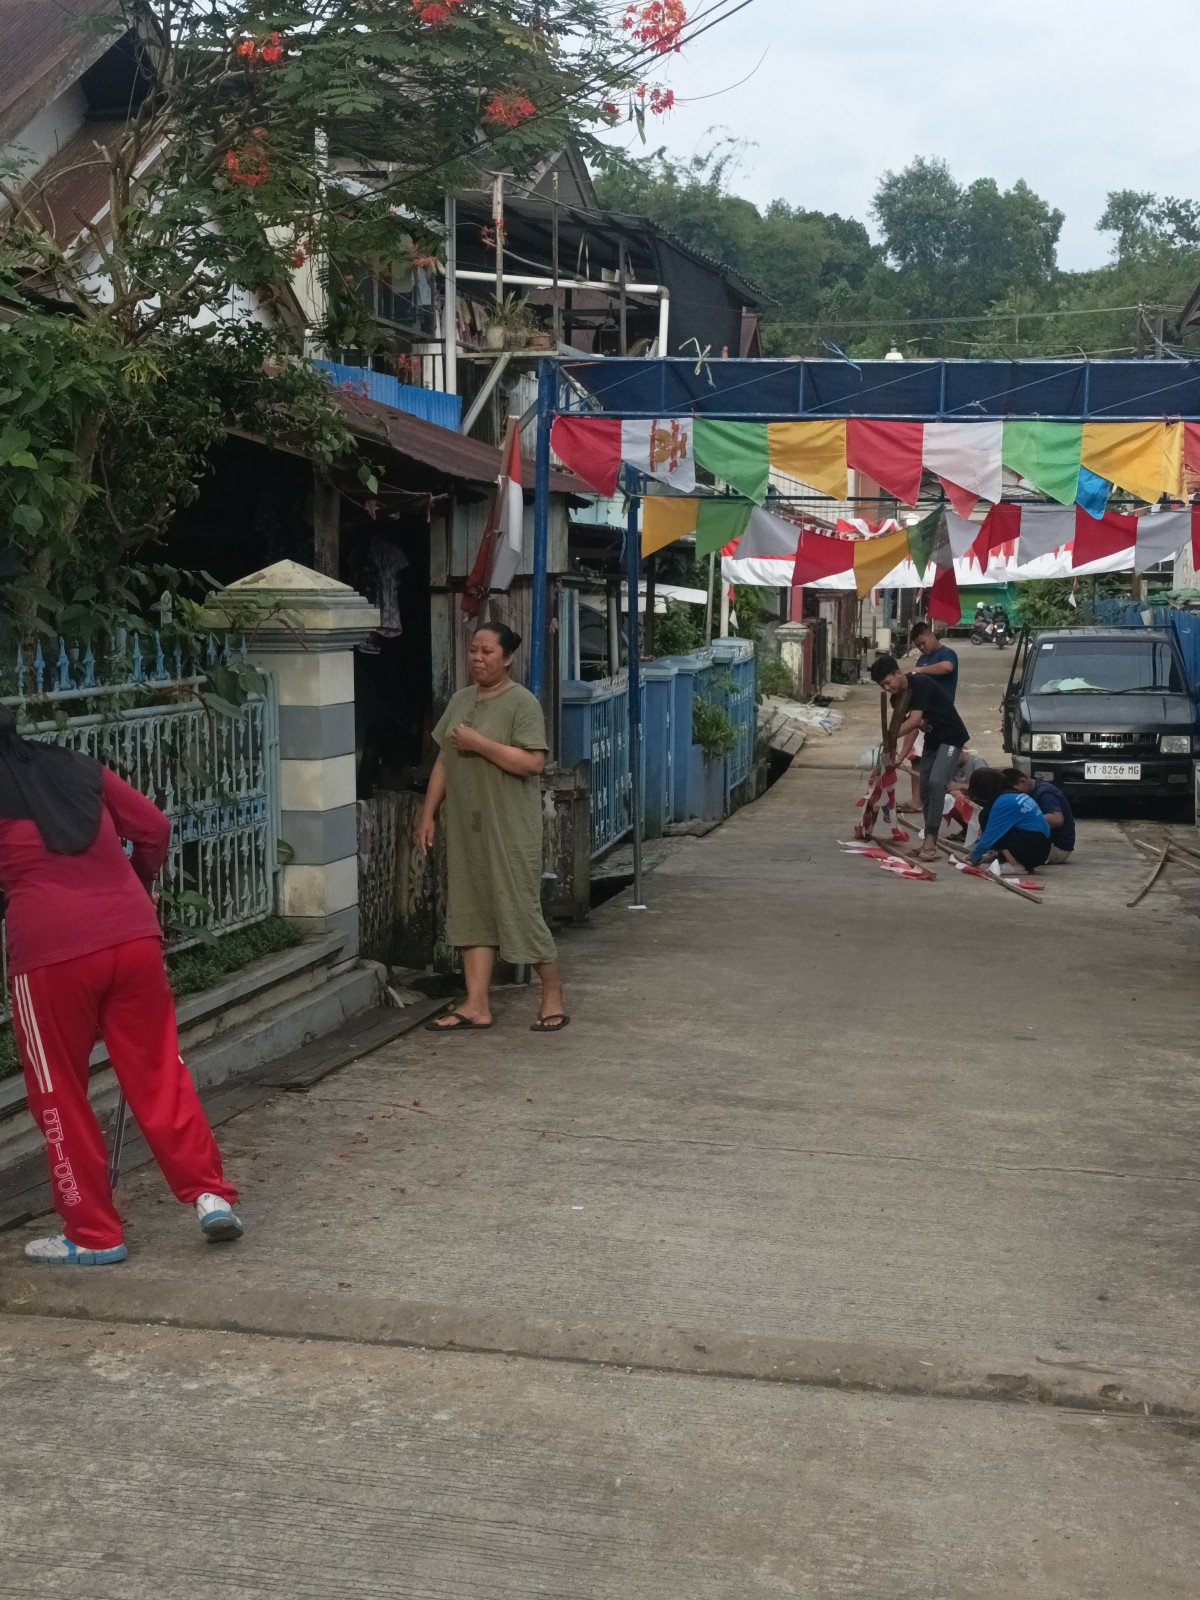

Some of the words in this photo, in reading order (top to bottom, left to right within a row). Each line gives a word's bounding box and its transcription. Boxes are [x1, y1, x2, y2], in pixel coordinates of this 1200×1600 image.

[1086, 765, 1097, 775] KT
[1128, 765, 1139, 775] MG
[42, 1108, 82, 1207] adidas
